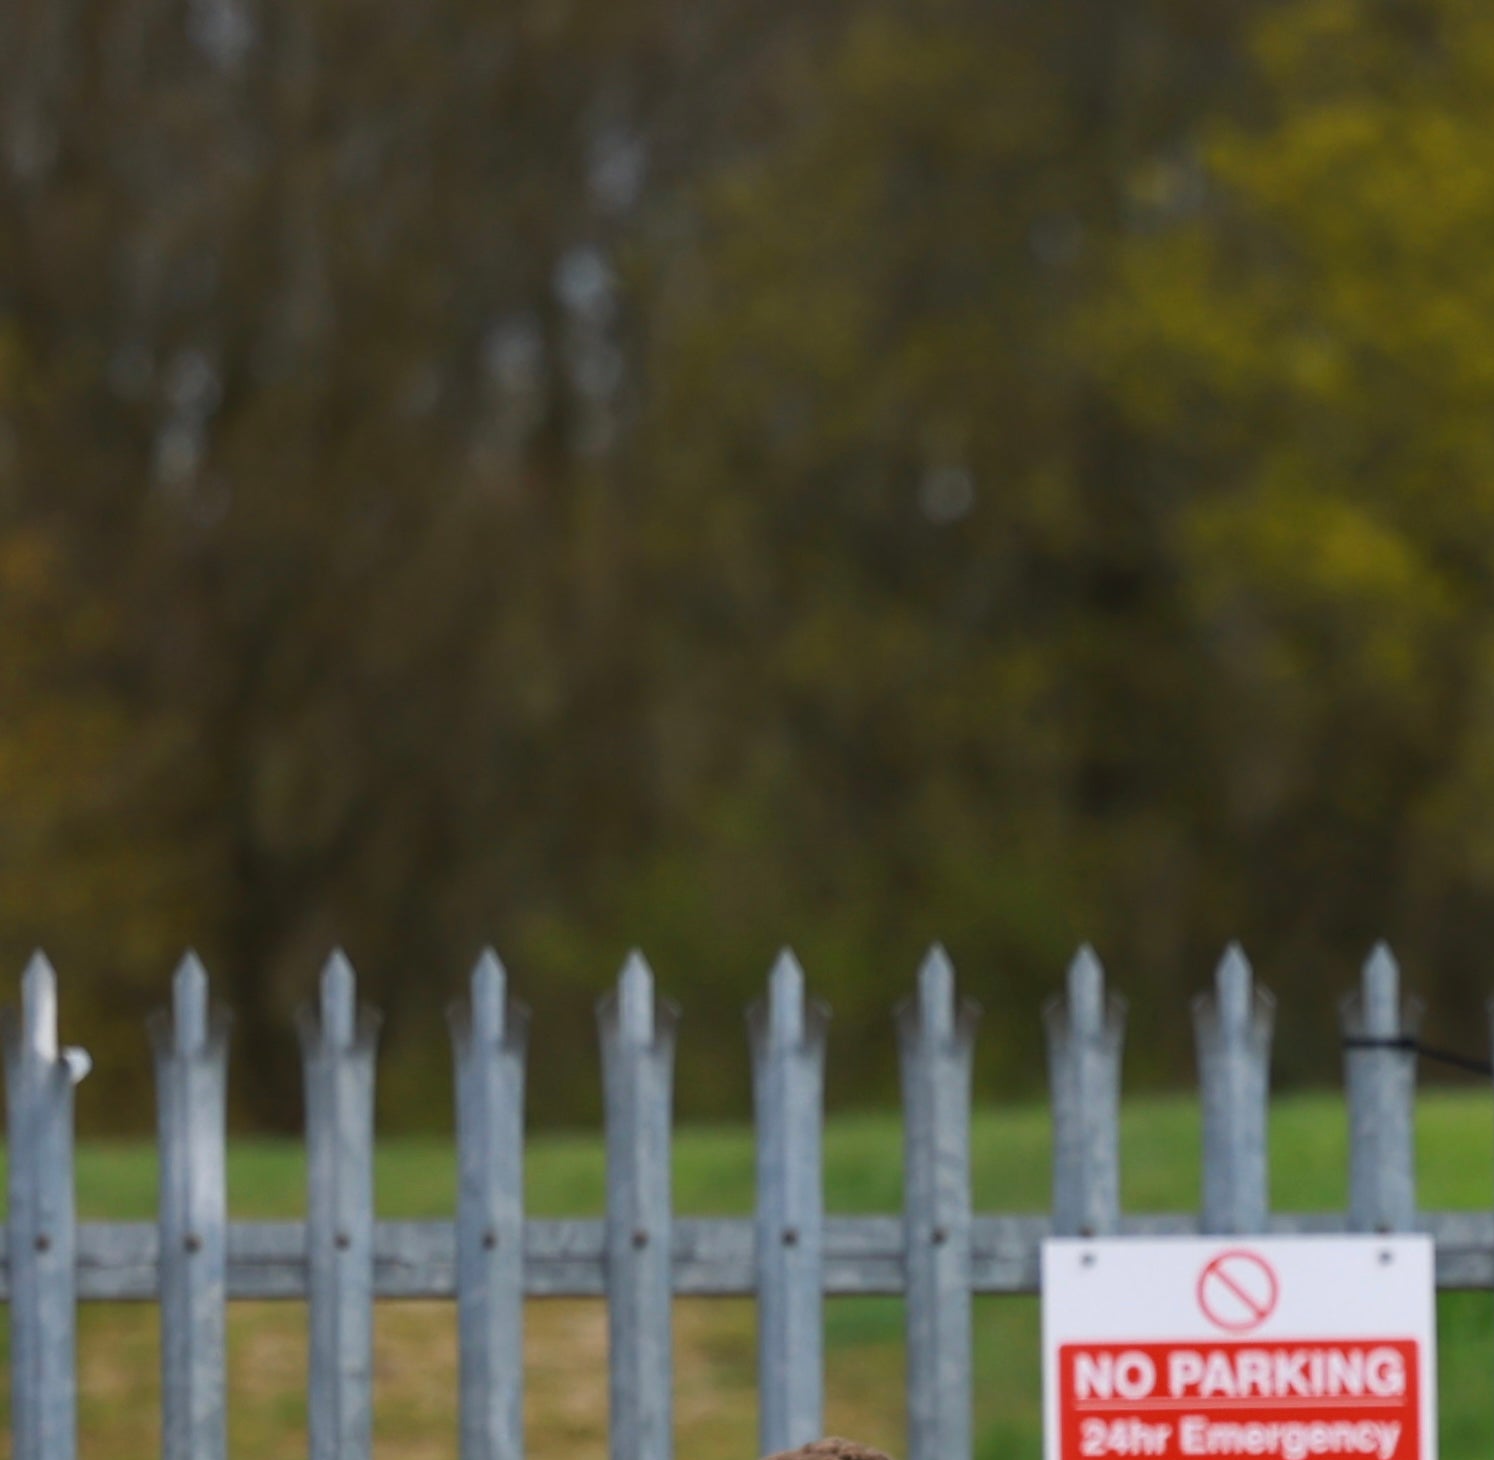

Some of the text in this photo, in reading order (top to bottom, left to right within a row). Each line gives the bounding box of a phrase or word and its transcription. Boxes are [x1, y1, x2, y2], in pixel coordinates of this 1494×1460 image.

[1074, 1347, 1405, 1400] NO PARKING
[1080, 1417, 1172, 1457] 24hr
